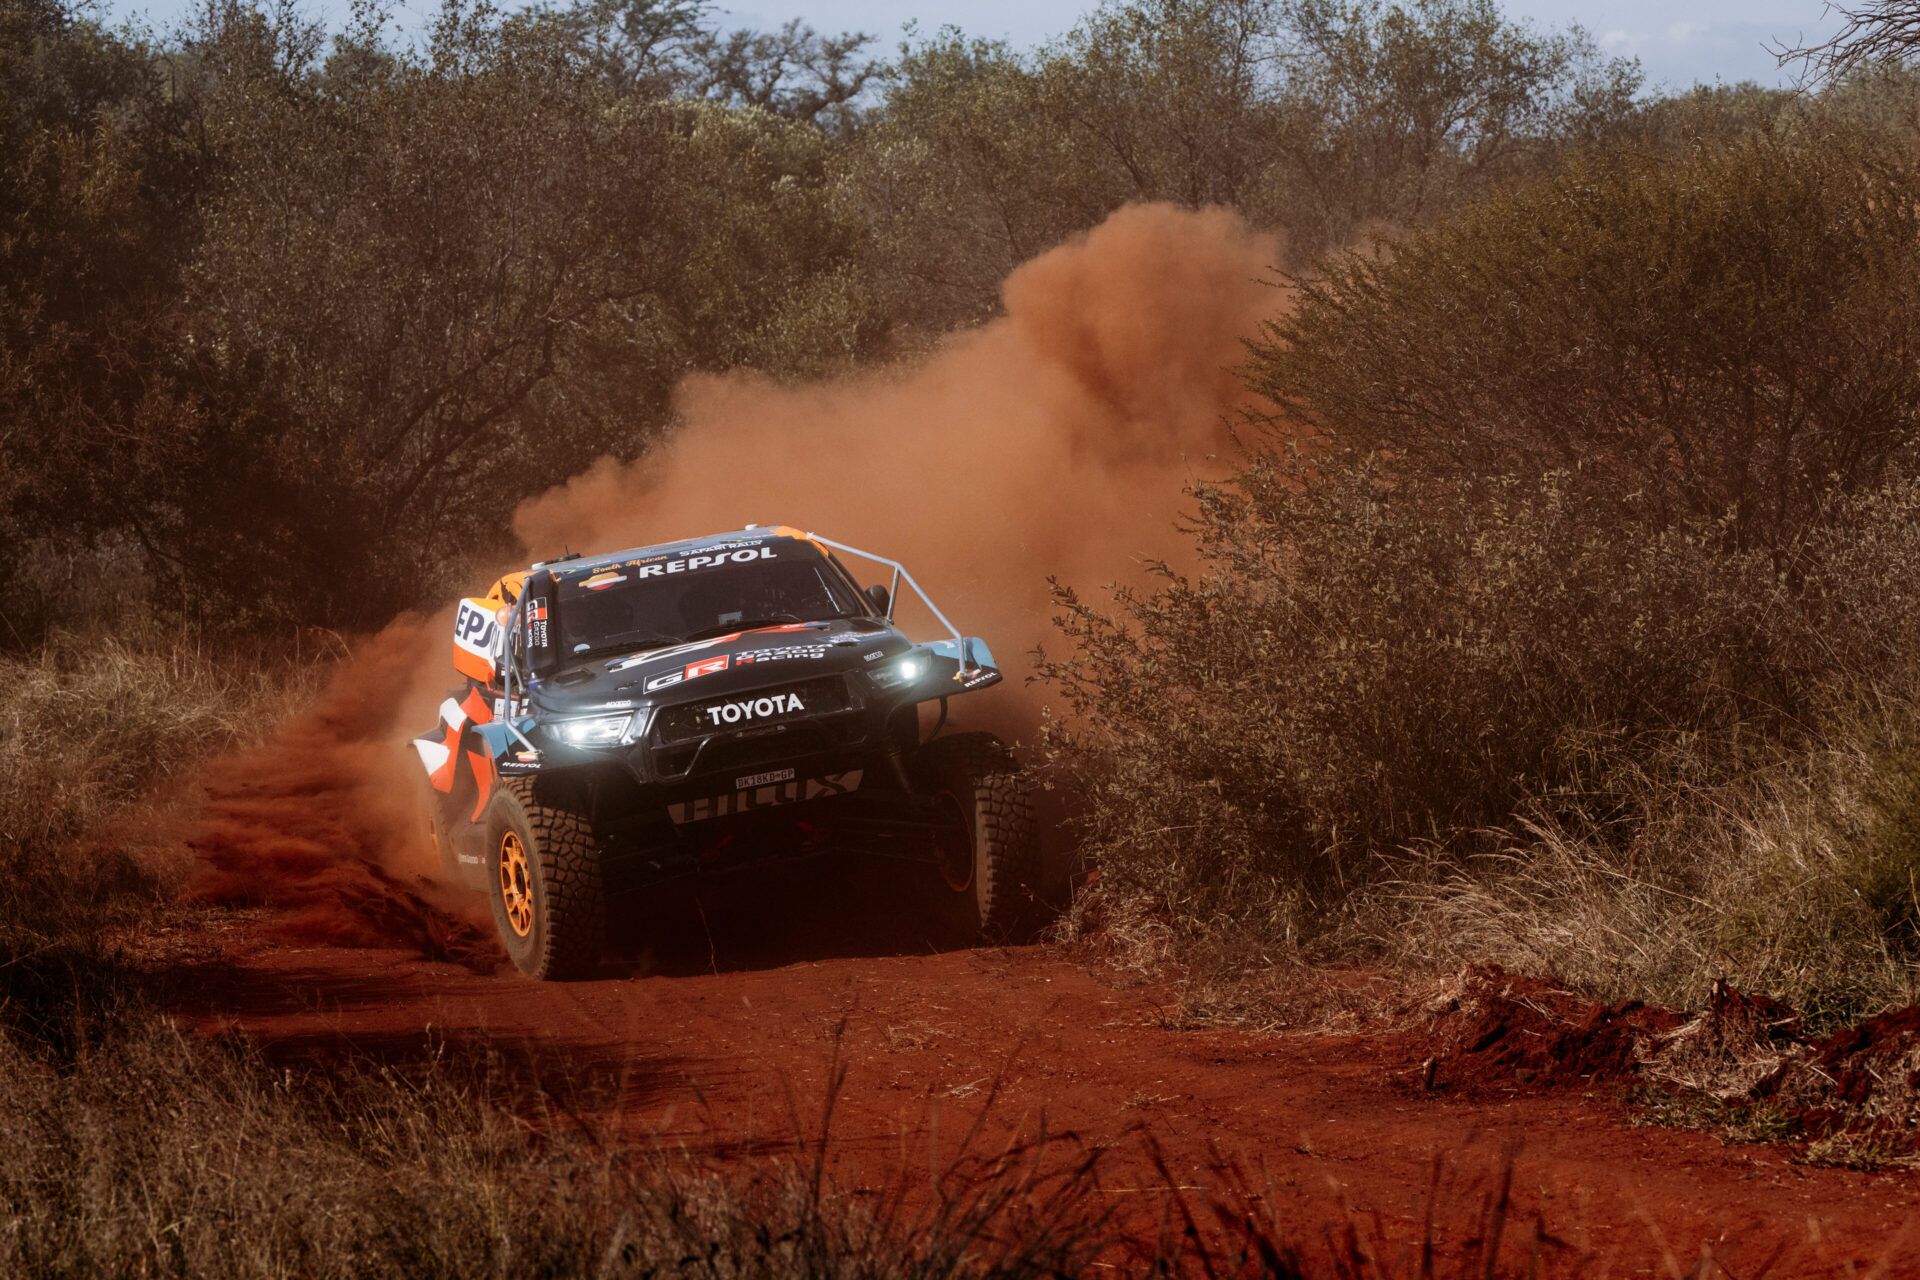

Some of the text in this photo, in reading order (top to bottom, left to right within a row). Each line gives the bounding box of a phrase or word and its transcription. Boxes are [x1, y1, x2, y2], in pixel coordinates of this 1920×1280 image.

[679, 540, 763, 557] SAFARI RALLY
[592, 554, 669, 574] South African
[639, 547, 778, 579] REPSOL
[540, 620, 548, 648] TOYOTA
[735, 643, 834, 656] TOYOTA
[735, 653, 825, 666] Racing
[646, 659, 726, 690] GR
[964, 672, 998, 688] REPSOL
[706, 693, 805, 726] TOYOTA
[502, 761, 542, 769] REPSOL
